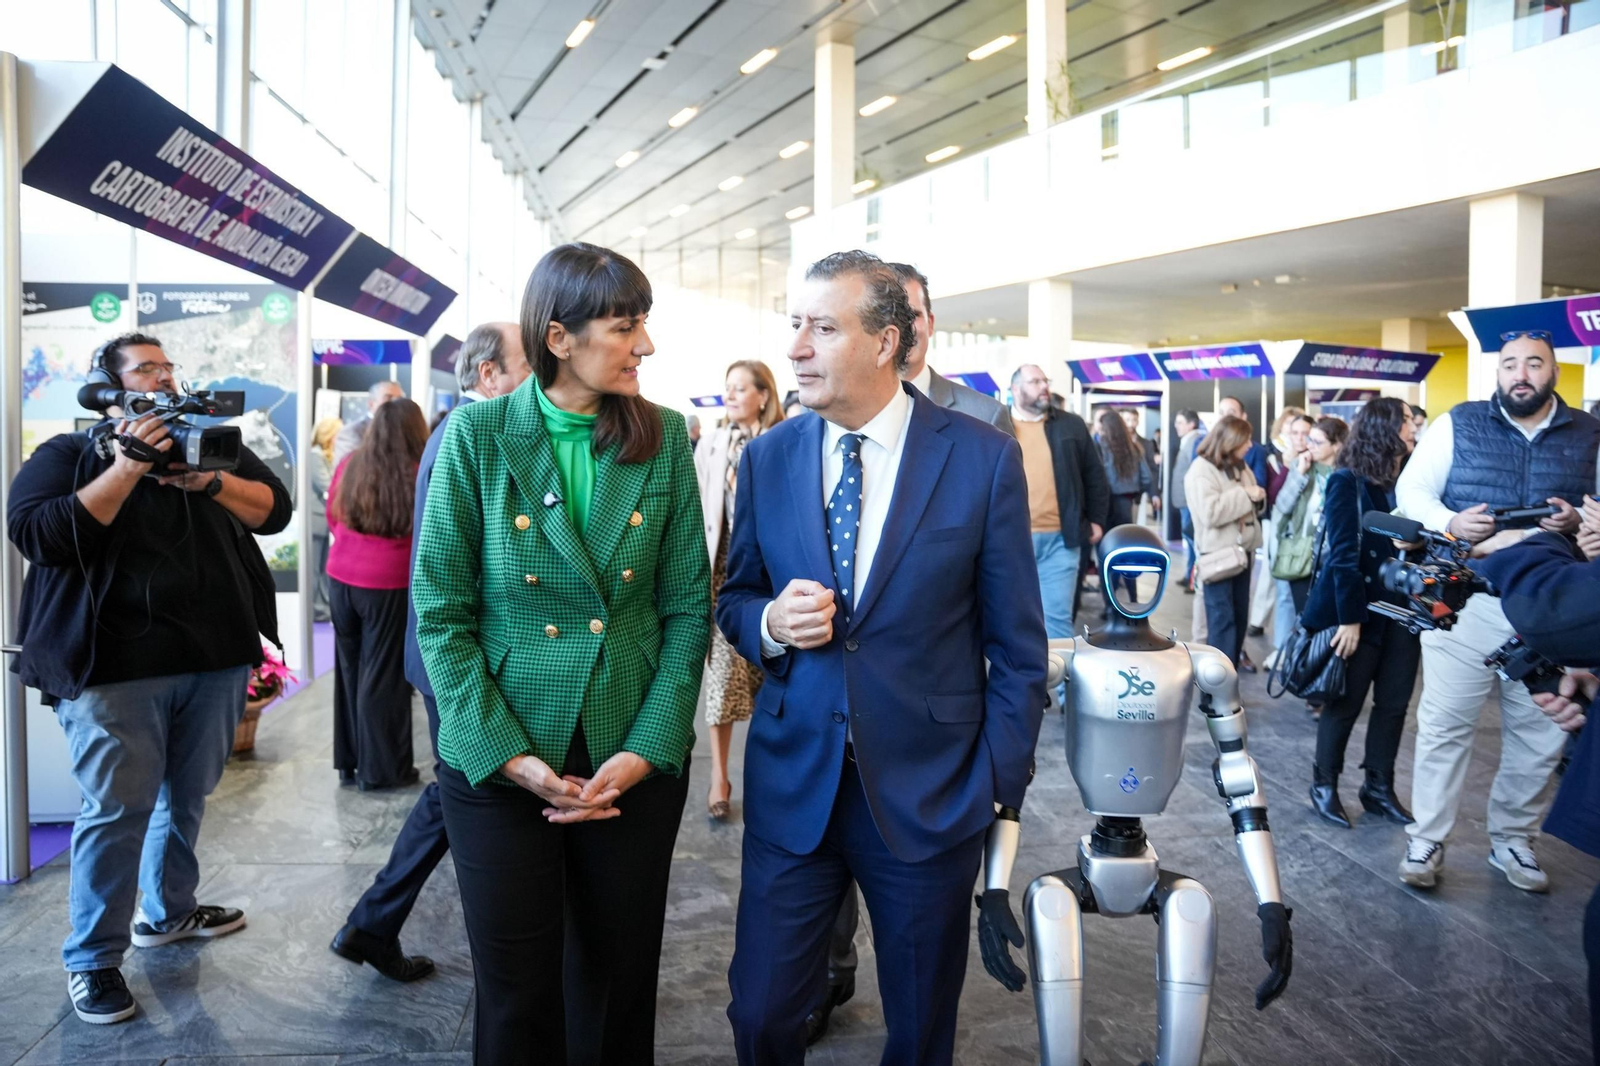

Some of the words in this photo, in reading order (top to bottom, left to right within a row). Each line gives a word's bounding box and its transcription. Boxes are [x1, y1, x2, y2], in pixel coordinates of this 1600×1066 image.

[89, 159, 211, 234] CARTOGRAFÍA
[194, 210, 228, 242] DE
[156, 125, 243, 193] INSTITUTO
[226, 168, 260, 202] DE
[301, 213, 324, 238] Y
[1117, 709, 1155, 720] Sevilla
